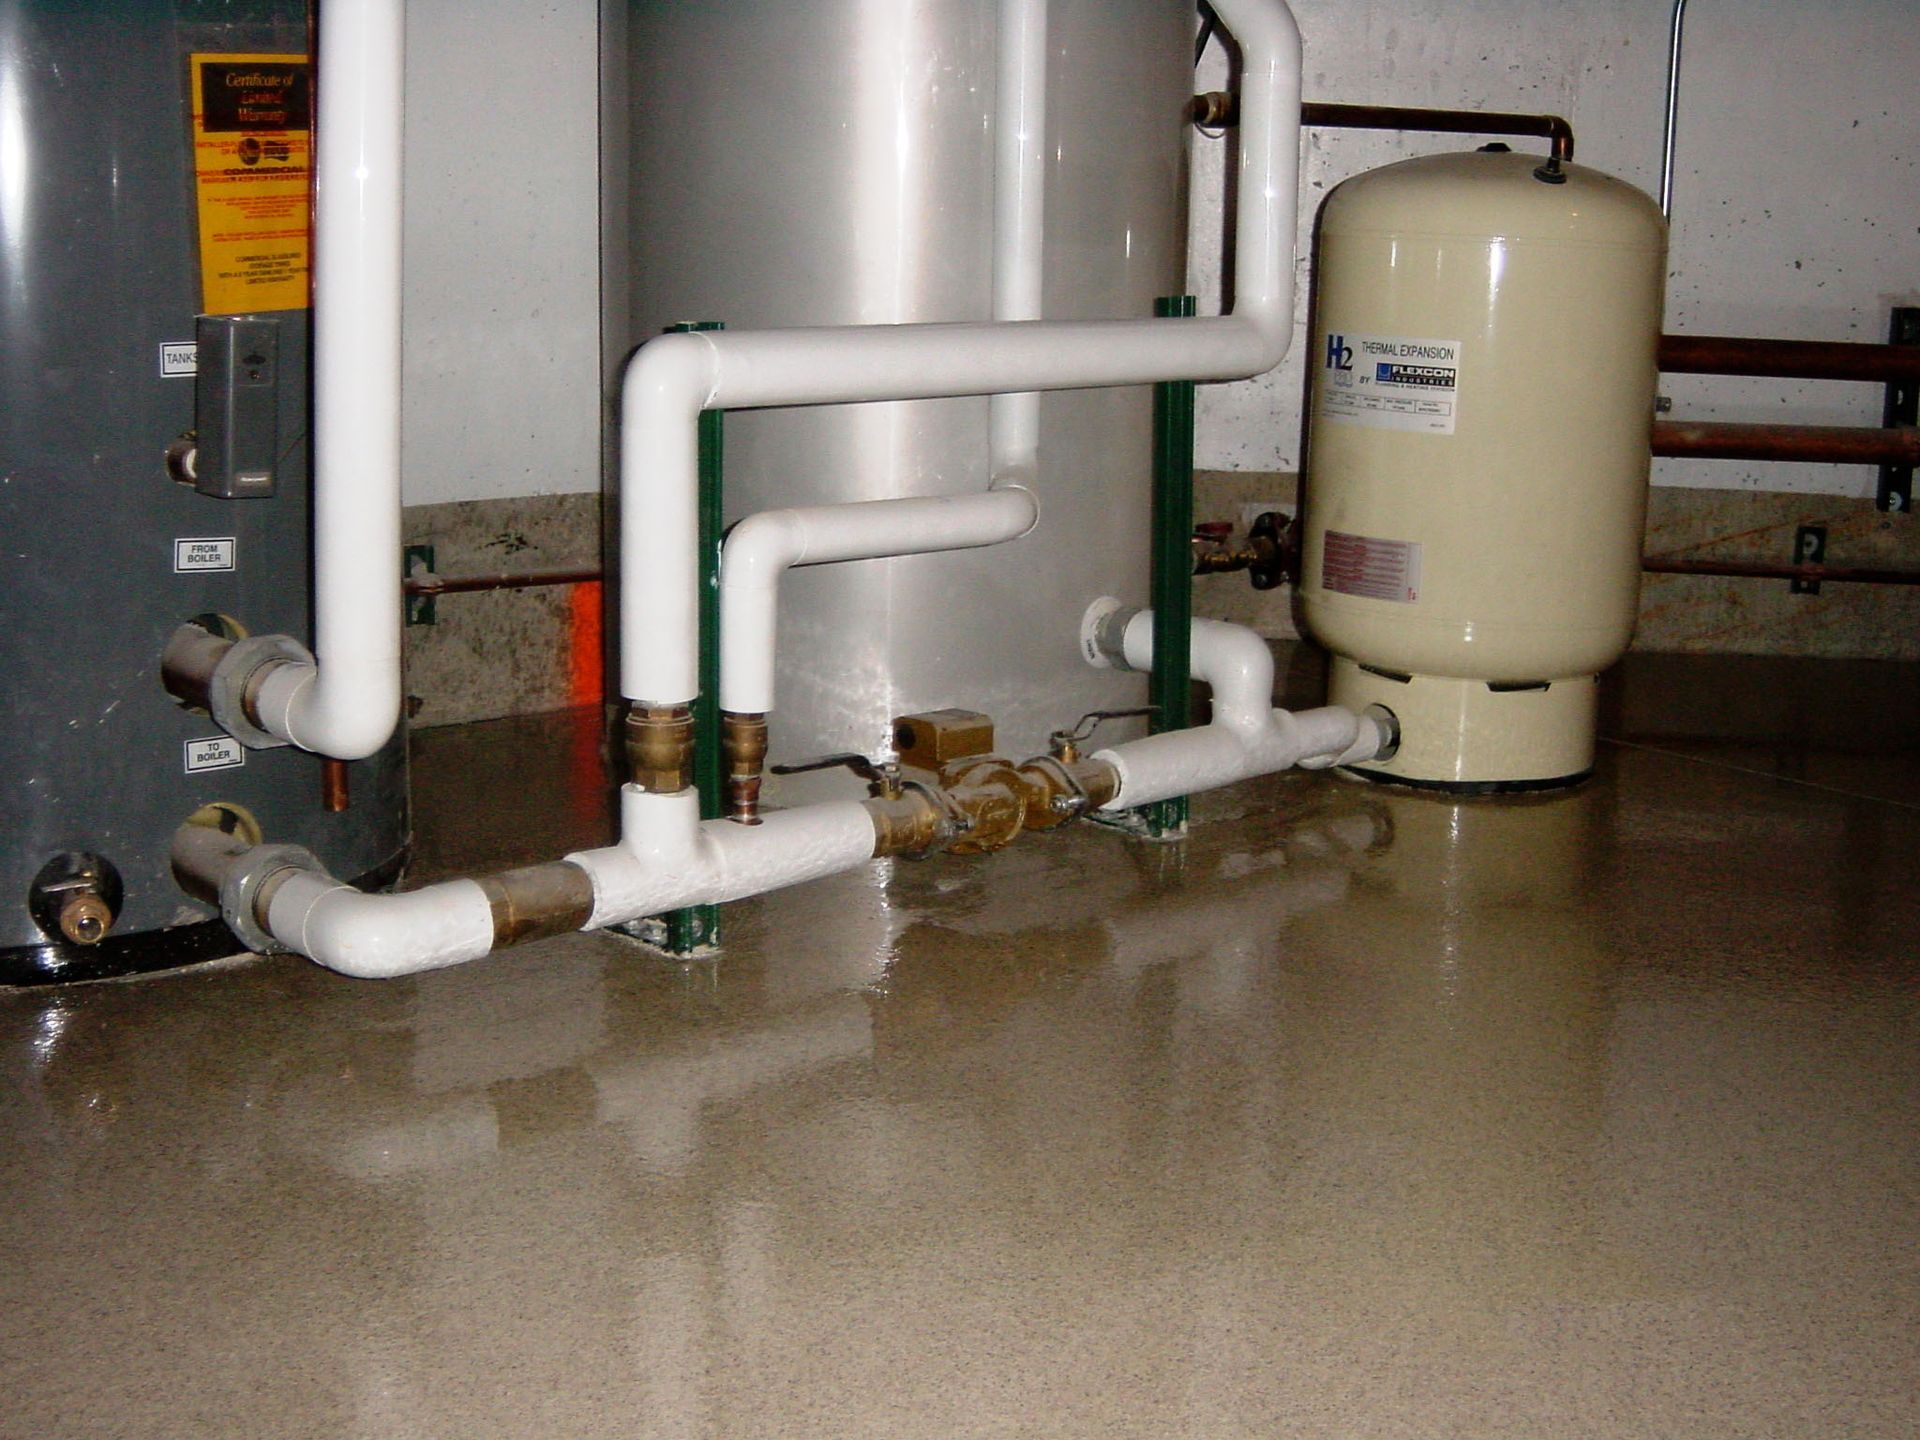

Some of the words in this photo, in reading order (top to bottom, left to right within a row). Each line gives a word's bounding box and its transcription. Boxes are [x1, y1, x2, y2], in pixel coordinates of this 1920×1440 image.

[226, 72, 280, 87] Certificate
[283, 73, 294, 87] of
[224, 167, 304, 175] COMMERCIAL
[1362, 341, 1398, 357] THERMAL
[1400, 344, 1454, 361] EXPANSION
[1392, 366, 1455, 378] FLEXCON
[1360, 375, 1371, 384] BY
[1391, 376, 1454, 386] INDUSTRIES
[191, 545, 218, 553] FROM
[187, 554, 221, 563] BOILER
[207, 743, 220, 751] TO
[197, 750, 230, 762] BOILER
